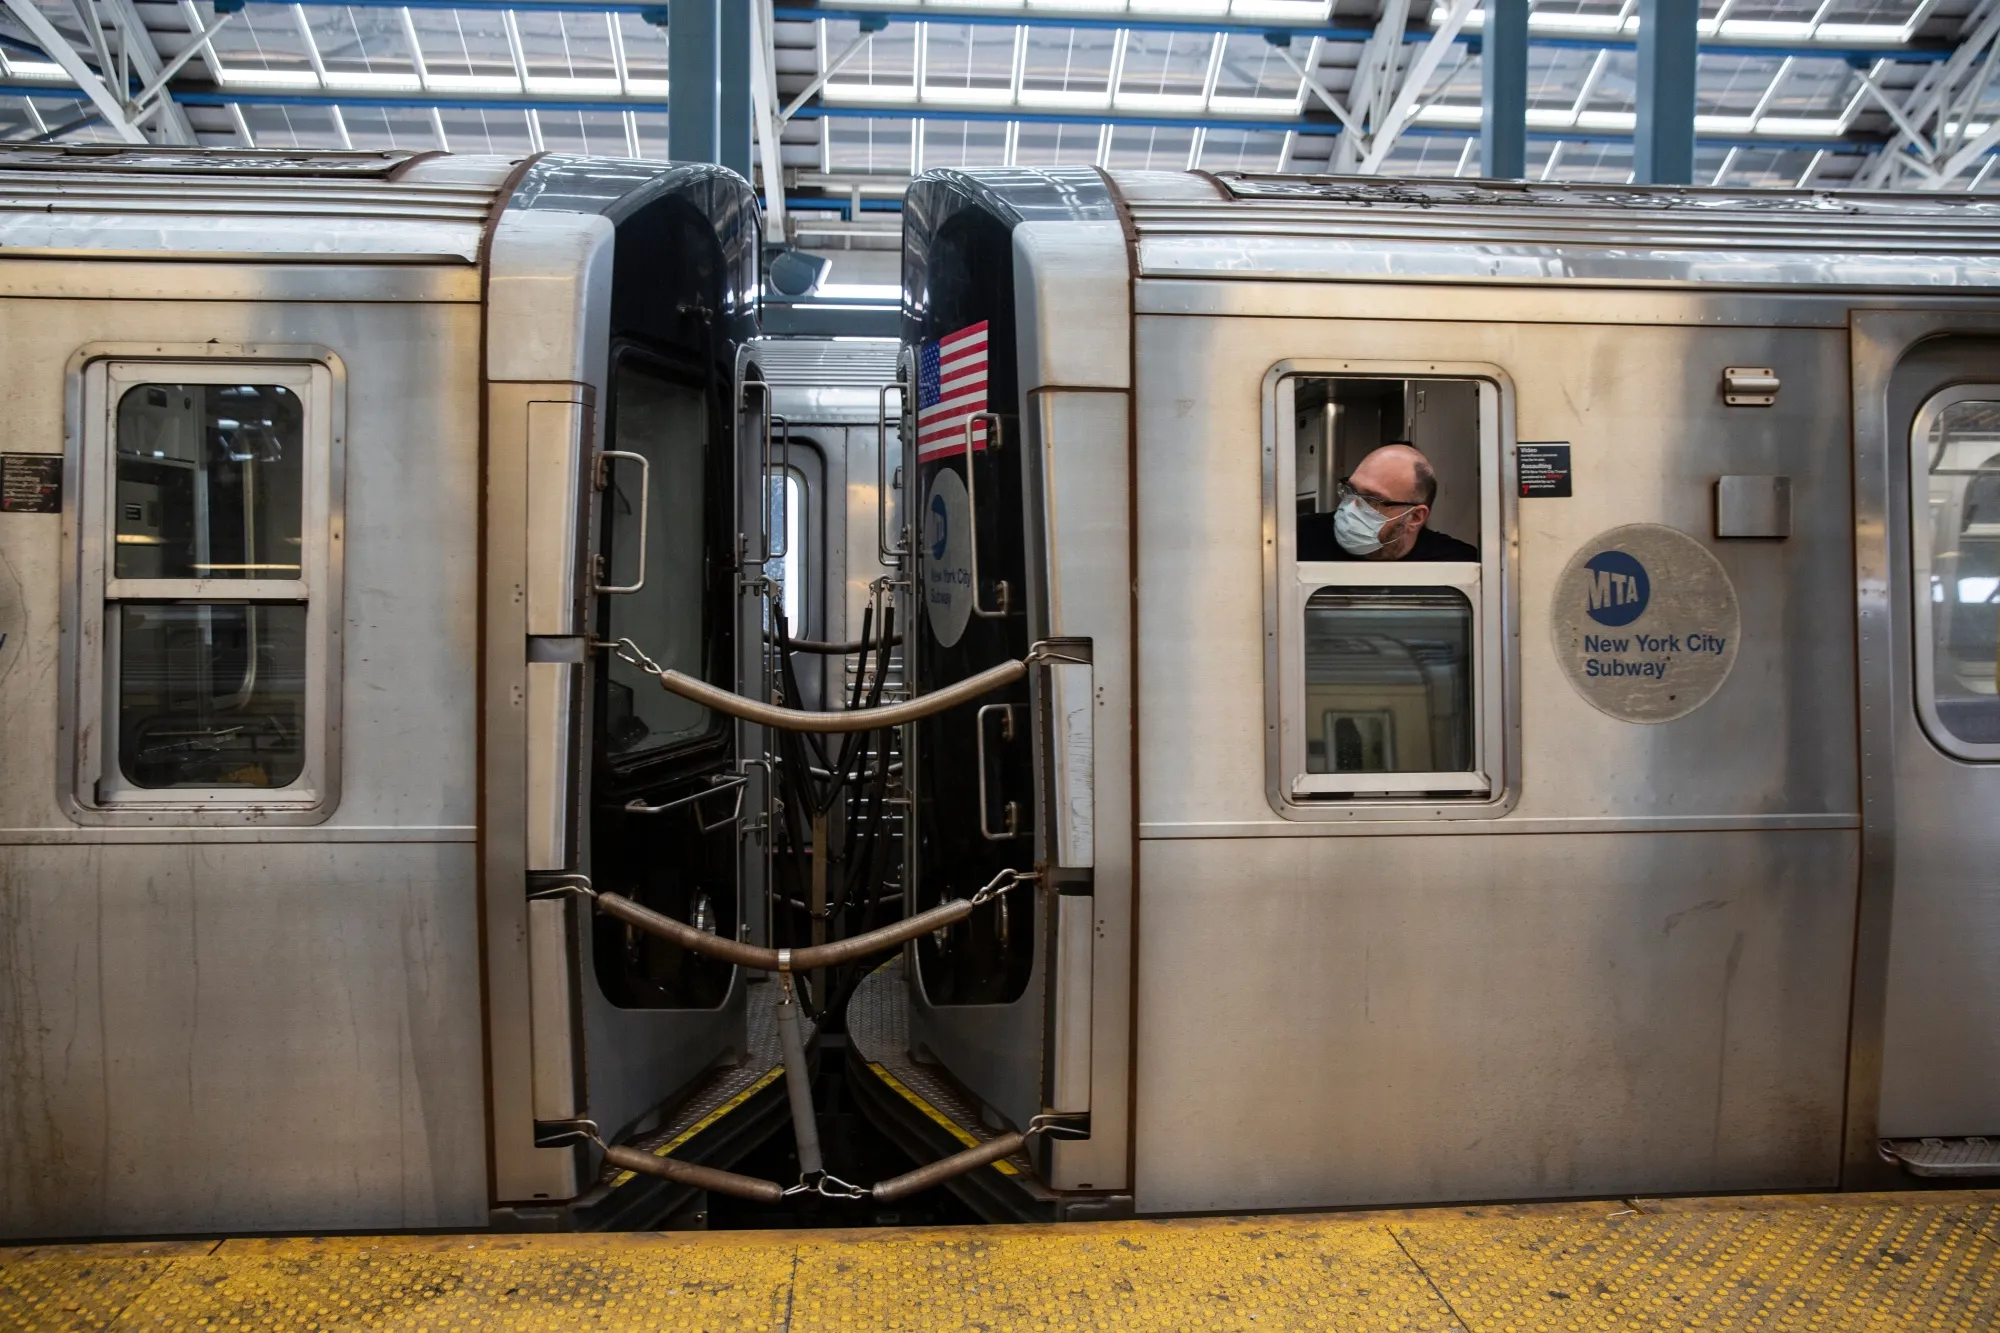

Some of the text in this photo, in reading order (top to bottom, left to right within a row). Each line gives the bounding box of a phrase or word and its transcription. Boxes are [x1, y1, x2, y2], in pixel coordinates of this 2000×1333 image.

[1522, 485, 1529, 494] 7
[958, 567, 971, 588] City
[1584, 568, 1639, 611] MTA
[1585, 633, 1726, 655] New York City
[1586, 659, 1667, 680] Subway
